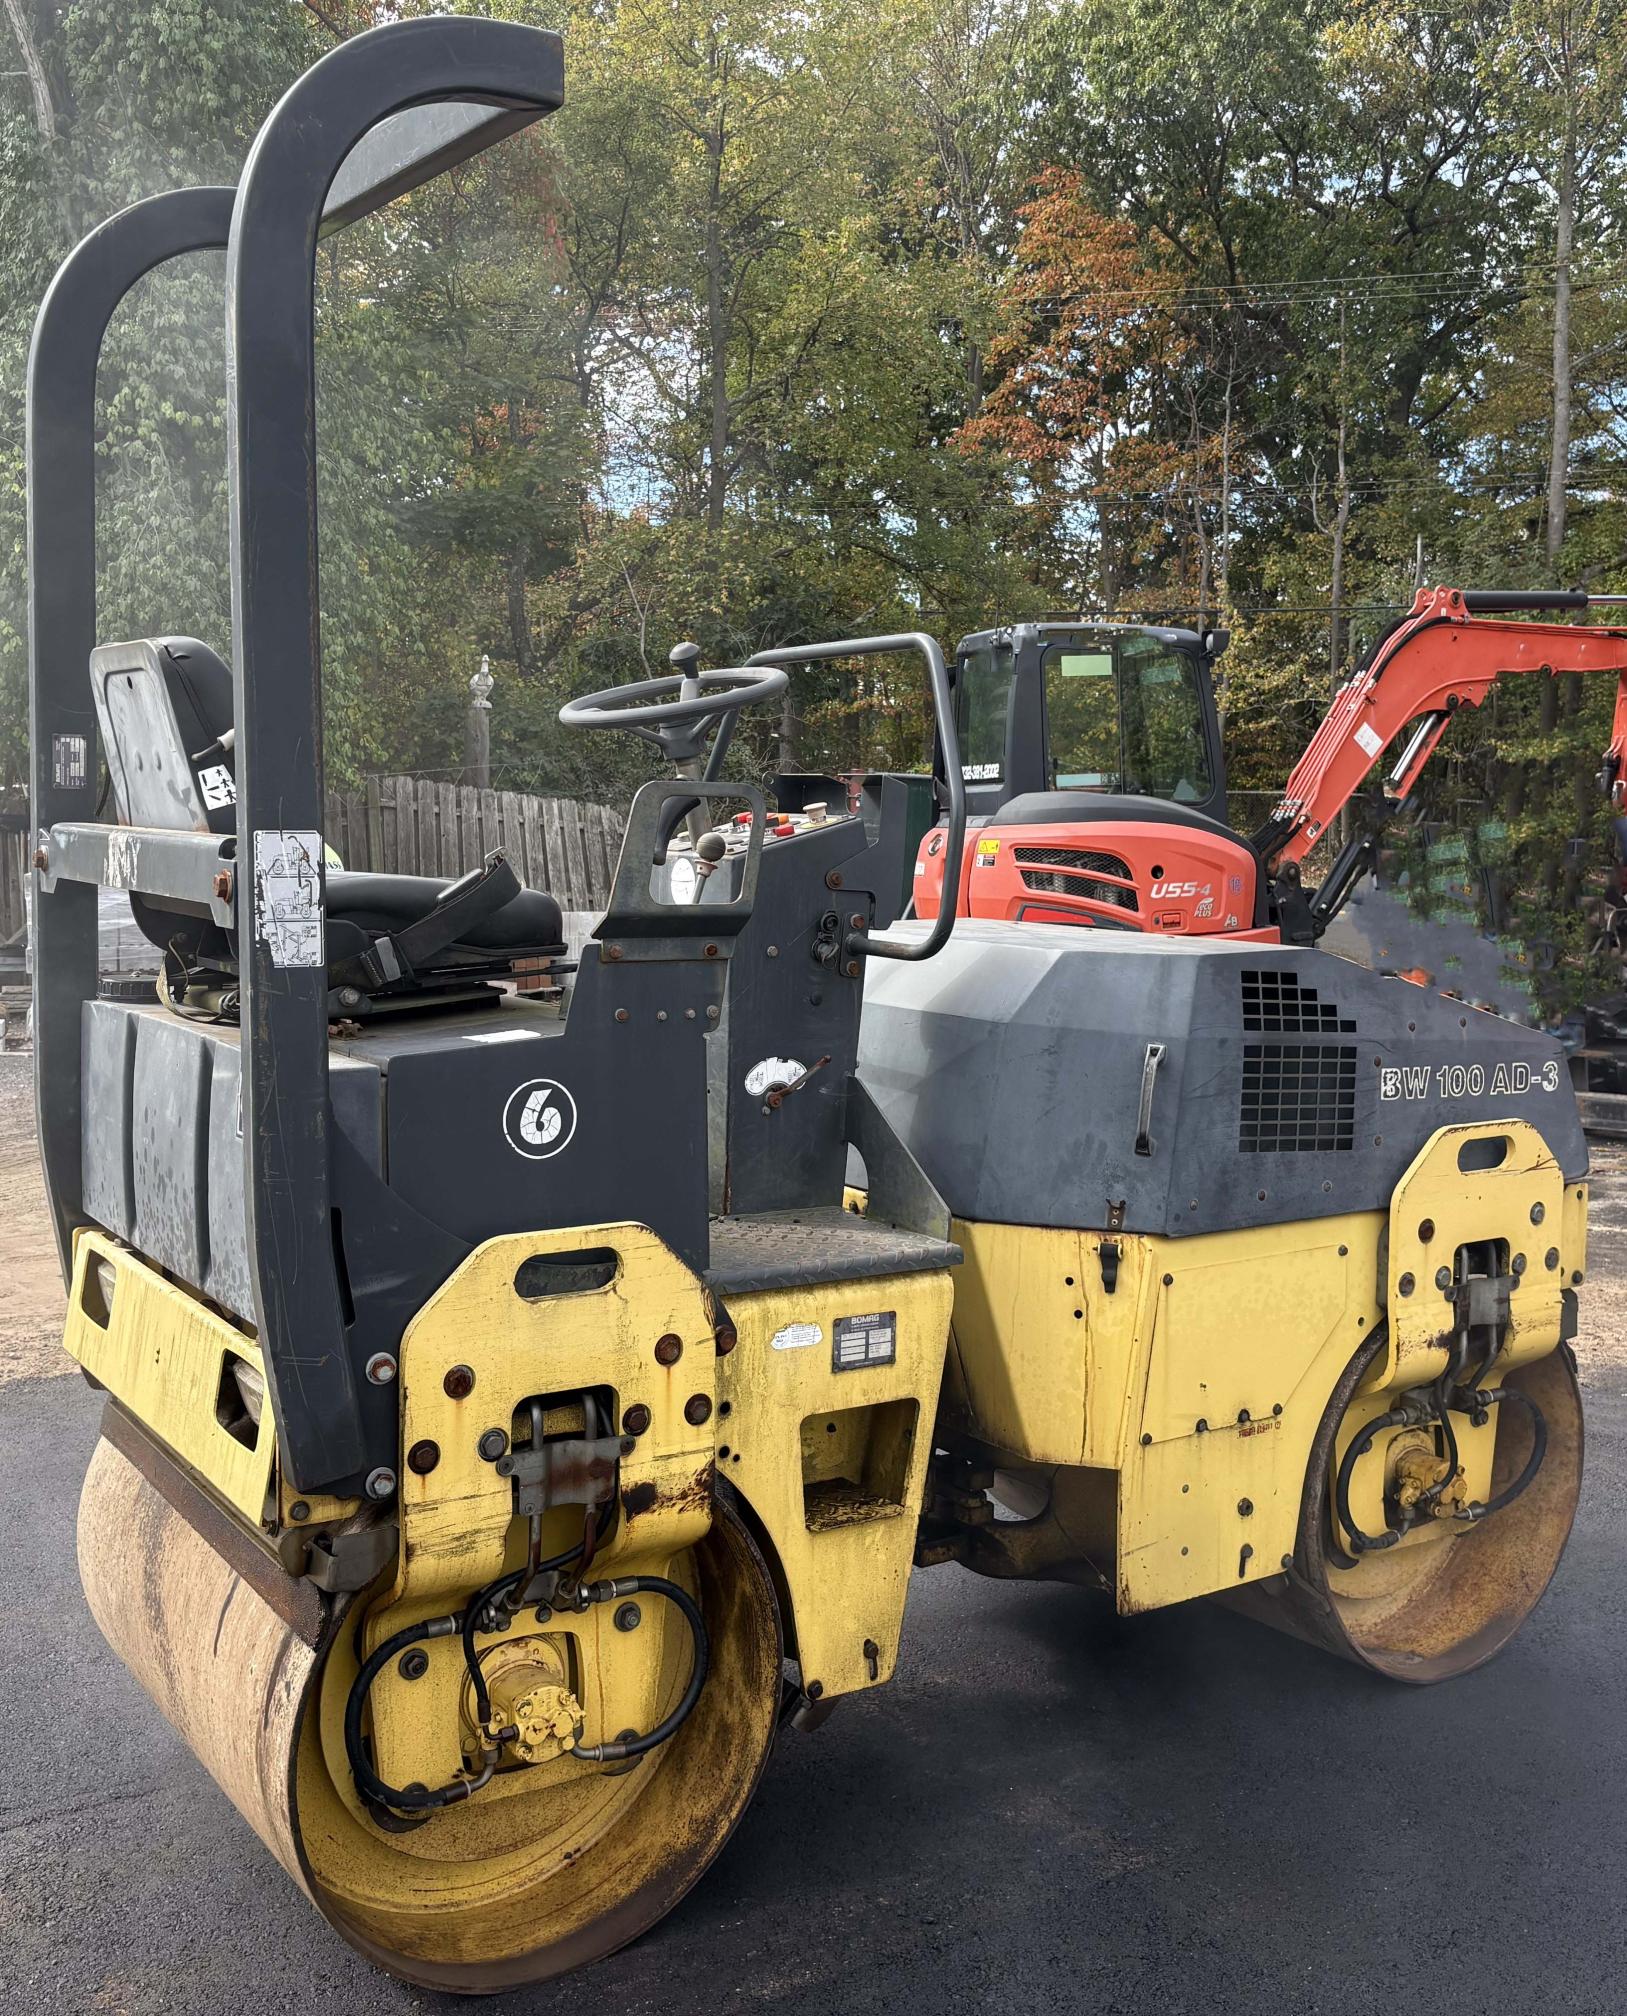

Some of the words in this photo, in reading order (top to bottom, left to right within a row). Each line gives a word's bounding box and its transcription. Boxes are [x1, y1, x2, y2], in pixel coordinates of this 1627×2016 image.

[1380, 1066, 1431, 1101] BW
[1436, 1064, 1485, 1098] 100
[1489, 1060, 1559, 1096] AD-3
[519, 1088, 553, 1145] 6
[851, 1314, 880, 1325] BOMAG
